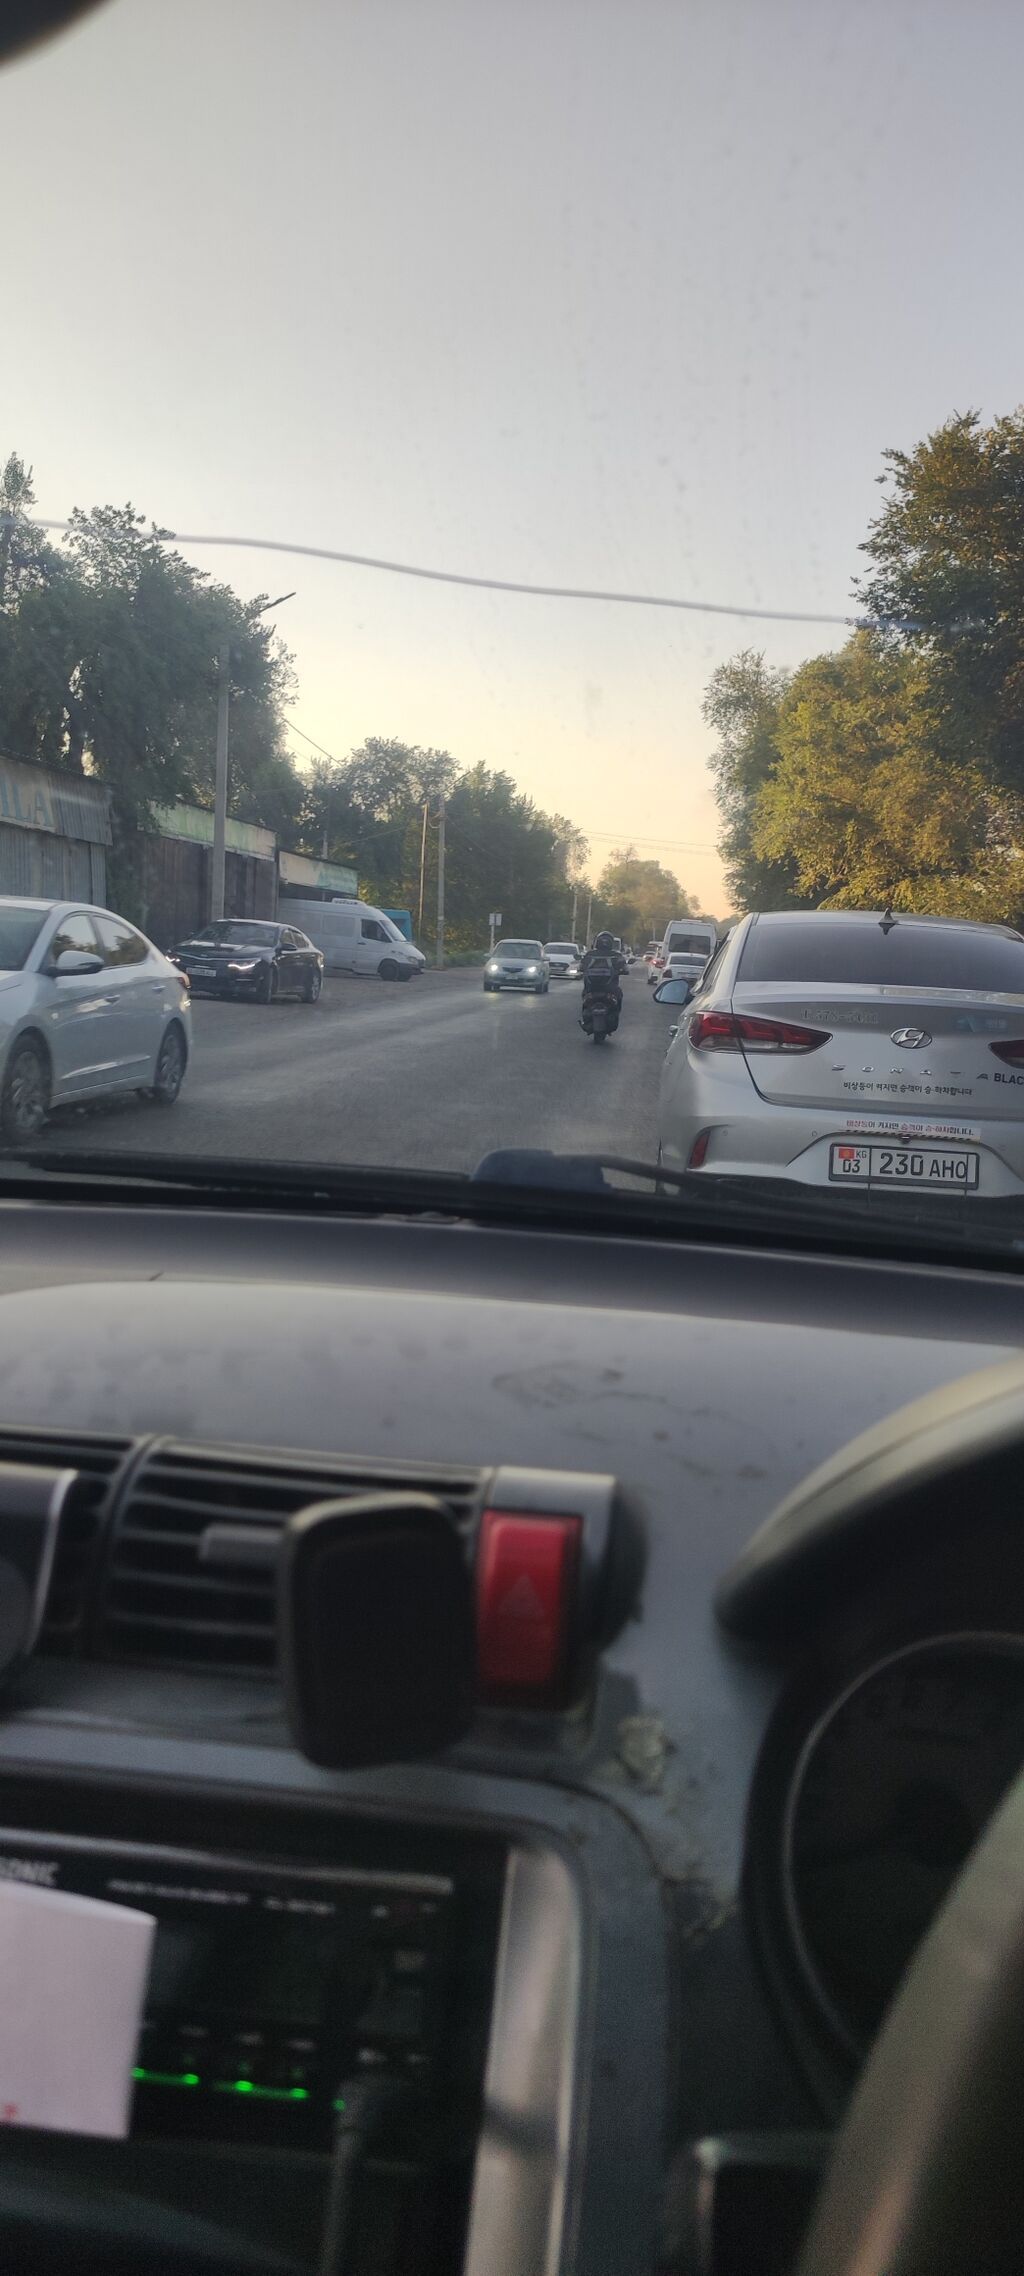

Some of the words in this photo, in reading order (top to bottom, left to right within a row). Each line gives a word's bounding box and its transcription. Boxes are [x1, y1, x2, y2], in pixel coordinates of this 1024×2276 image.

[843, 1081, 874, 1091] 비상등이
[899, 1084, 923, 1094] 승객이
[855, 1150, 867, 1159] KG
[842, 1159, 860, 1173] 03
[879, 1152, 924, 1176] 230
[929, 1159, 968, 1179] AHO
